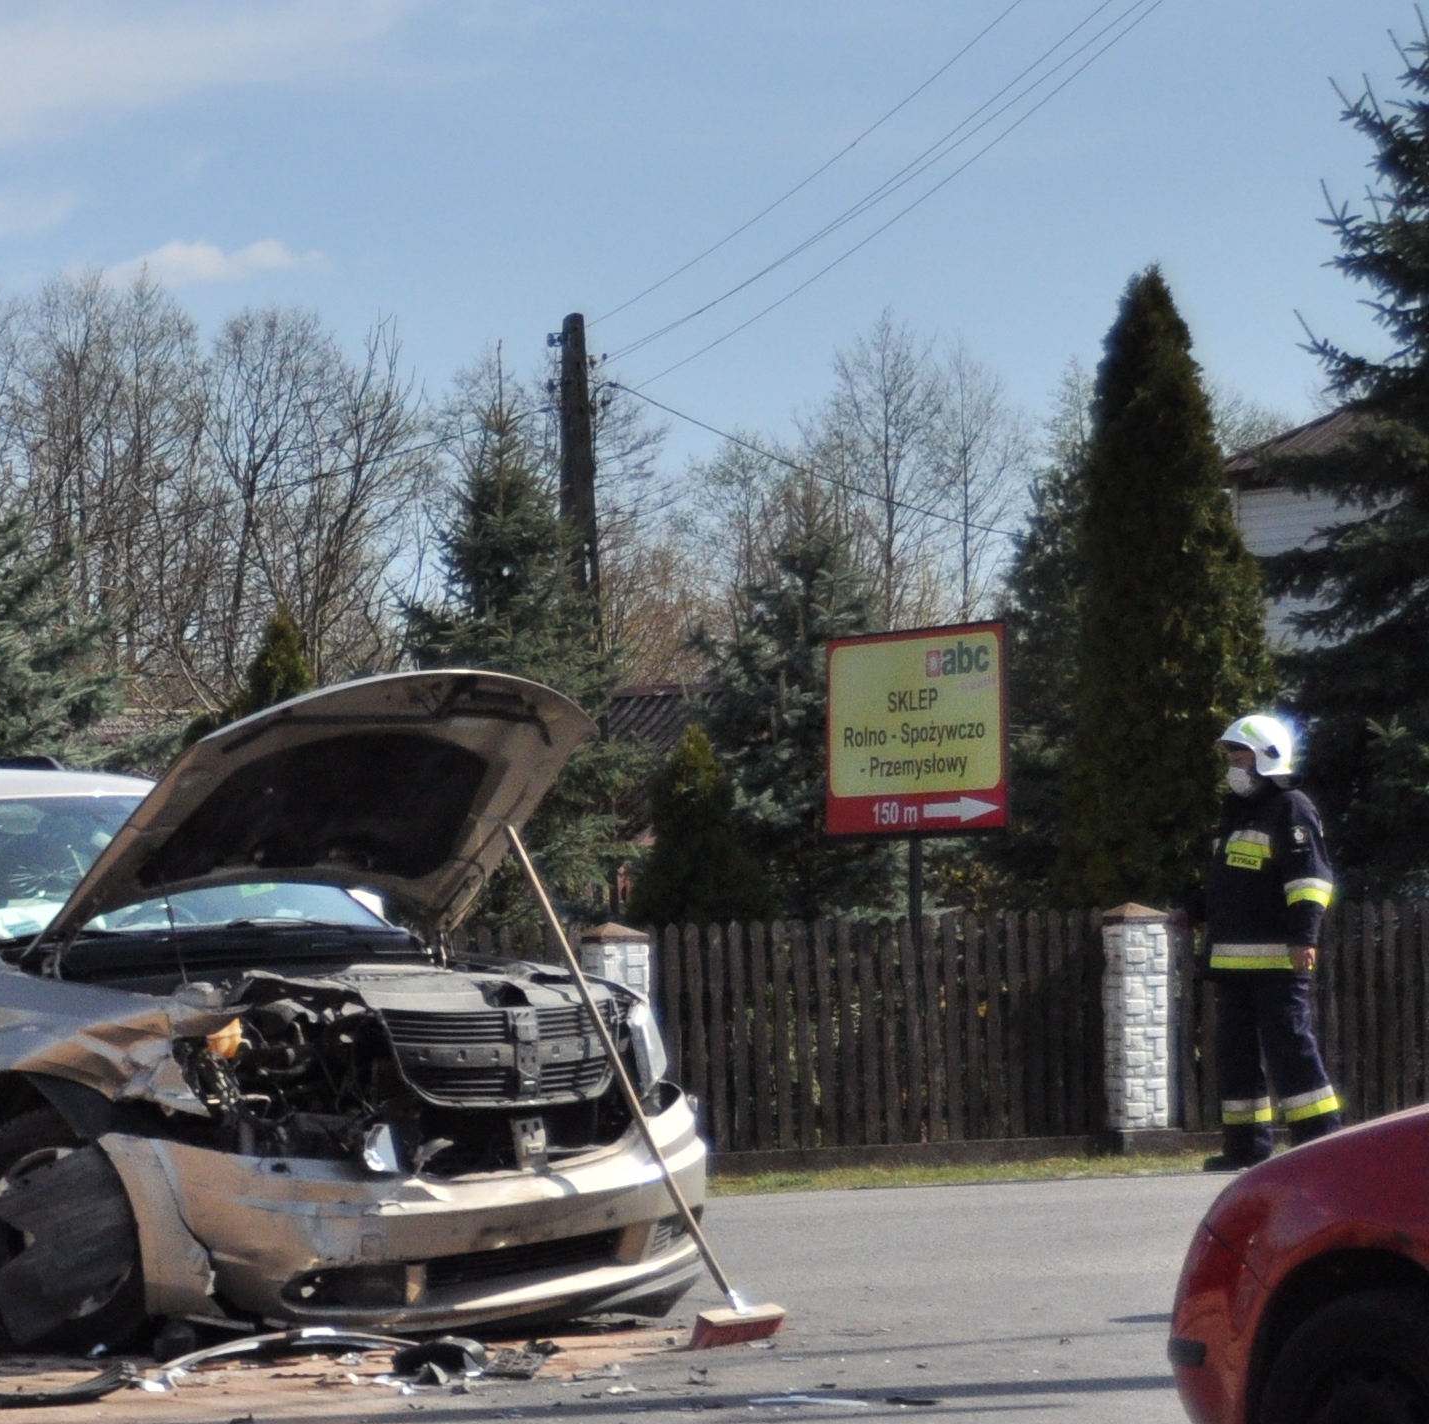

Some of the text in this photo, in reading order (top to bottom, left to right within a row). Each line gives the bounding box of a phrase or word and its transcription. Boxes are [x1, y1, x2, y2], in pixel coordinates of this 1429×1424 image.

[942, 641, 990, 676] abc
[887, 687, 938, 713] SKLEP
[844, 727, 887, 747] Rolno
[901, 720, 985, 748] Spożywczo
[870, 754, 968, 780] Przemysłowy
[873, 801, 917, 824] 150 m
